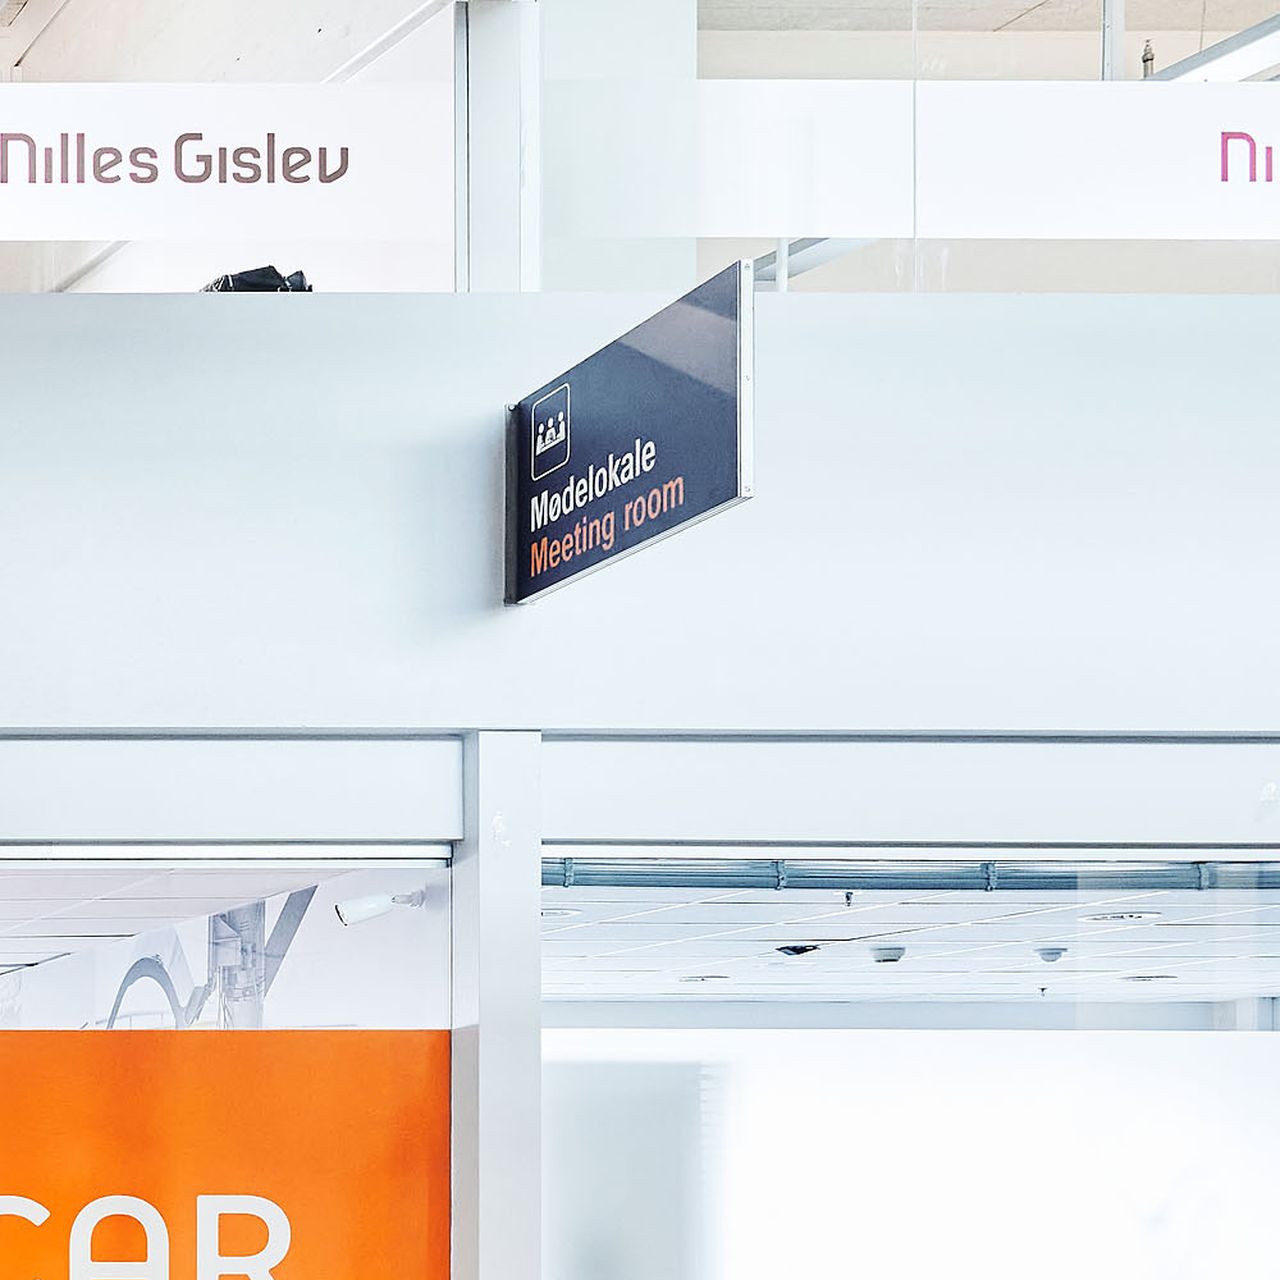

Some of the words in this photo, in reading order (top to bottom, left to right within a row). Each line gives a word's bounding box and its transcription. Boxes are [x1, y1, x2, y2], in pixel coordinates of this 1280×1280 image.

[175, 133, 348, 183] Gislev
[530, 438, 656, 533] Mødelokale
[530, 511, 615, 577] Meeting
[624, 476, 684, 531] room
